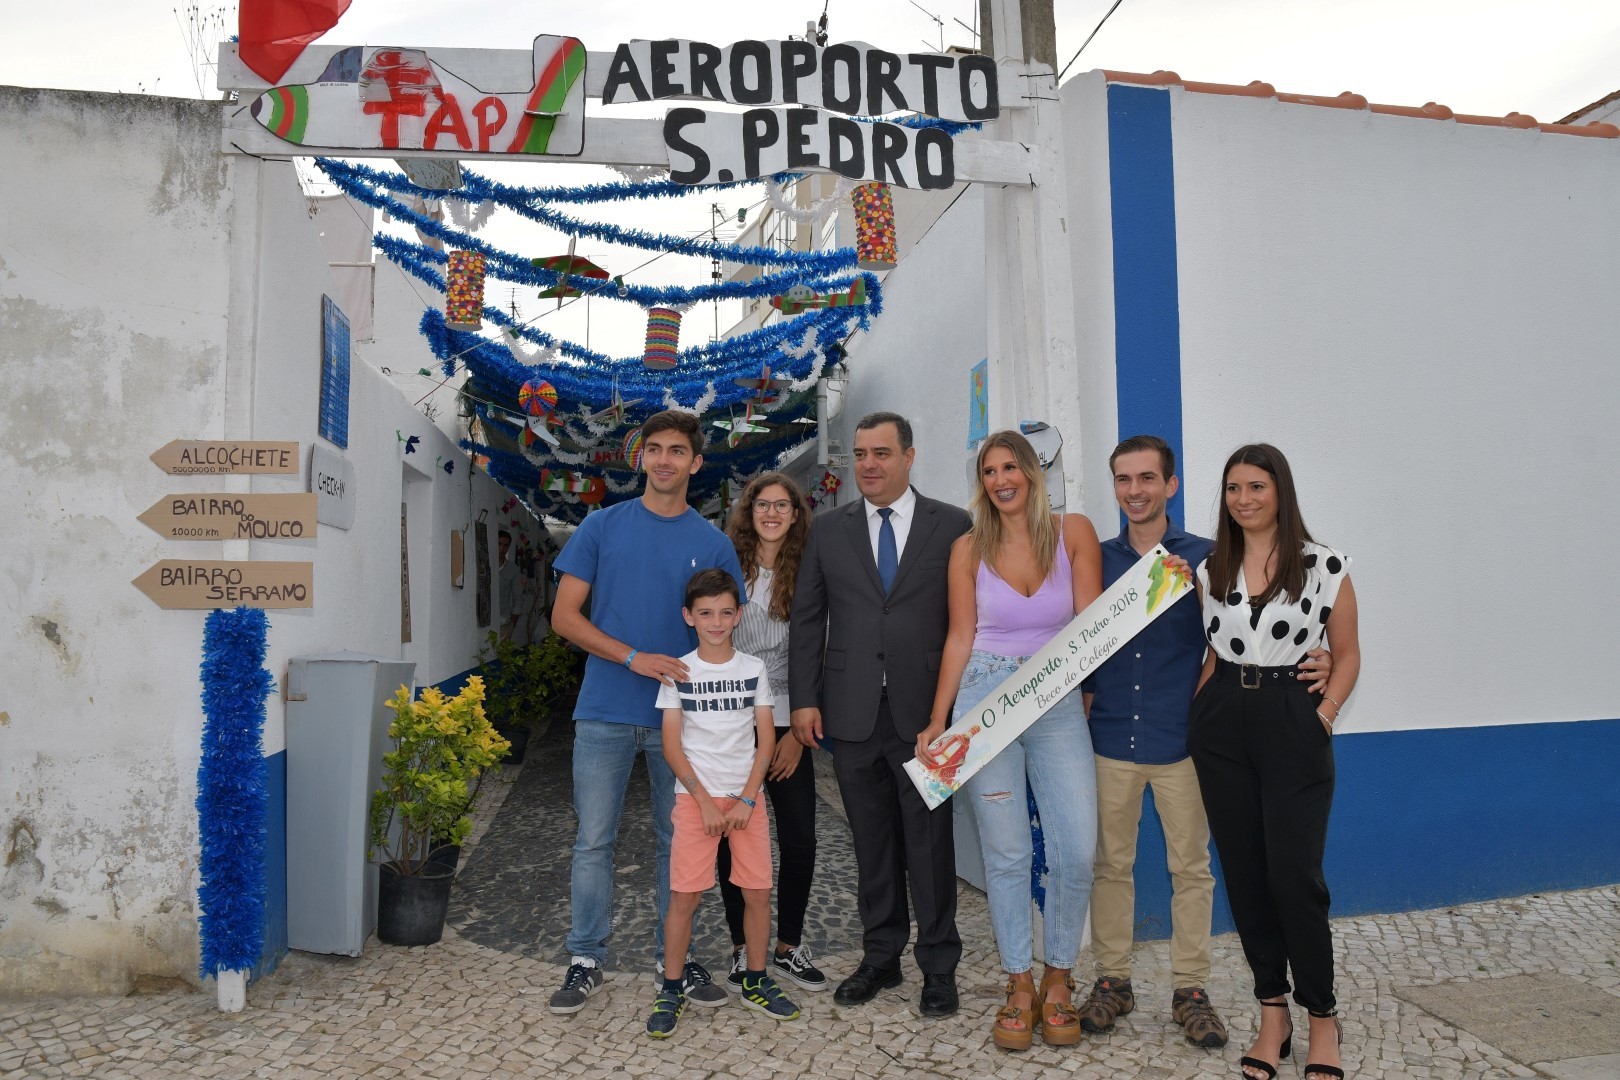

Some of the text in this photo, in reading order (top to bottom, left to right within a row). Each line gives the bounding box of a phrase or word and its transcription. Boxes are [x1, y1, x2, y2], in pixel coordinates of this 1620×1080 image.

[603, 40, 999, 120] AEROPORTO
[363, 93, 508, 152] TAP
[663, 108, 955, 190] S. PEDRO
[180, 447, 291, 468] ALCOCHETE
[172, 498, 245, 516] BAIRRO
[240, 513, 255, 522] DO
[171, 527, 204, 537] 10000
[237, 520, 303, 539] MOUCO
[160, 565, 243, 586] BAIRRO
[205, 583, 307, 602] SERRANO
[981, 708, 996, 728] O
[1068, 640, 1082, 655] S.
[1079, 617, 1110, 644] Pedro
[1109, 587, 1138, 618] 2018
[1034, 635, 1119, 709] Beco do Colégio
[692, 680, 747, 694] HILFIGER
[696, 696, 745, 712] DENIM
